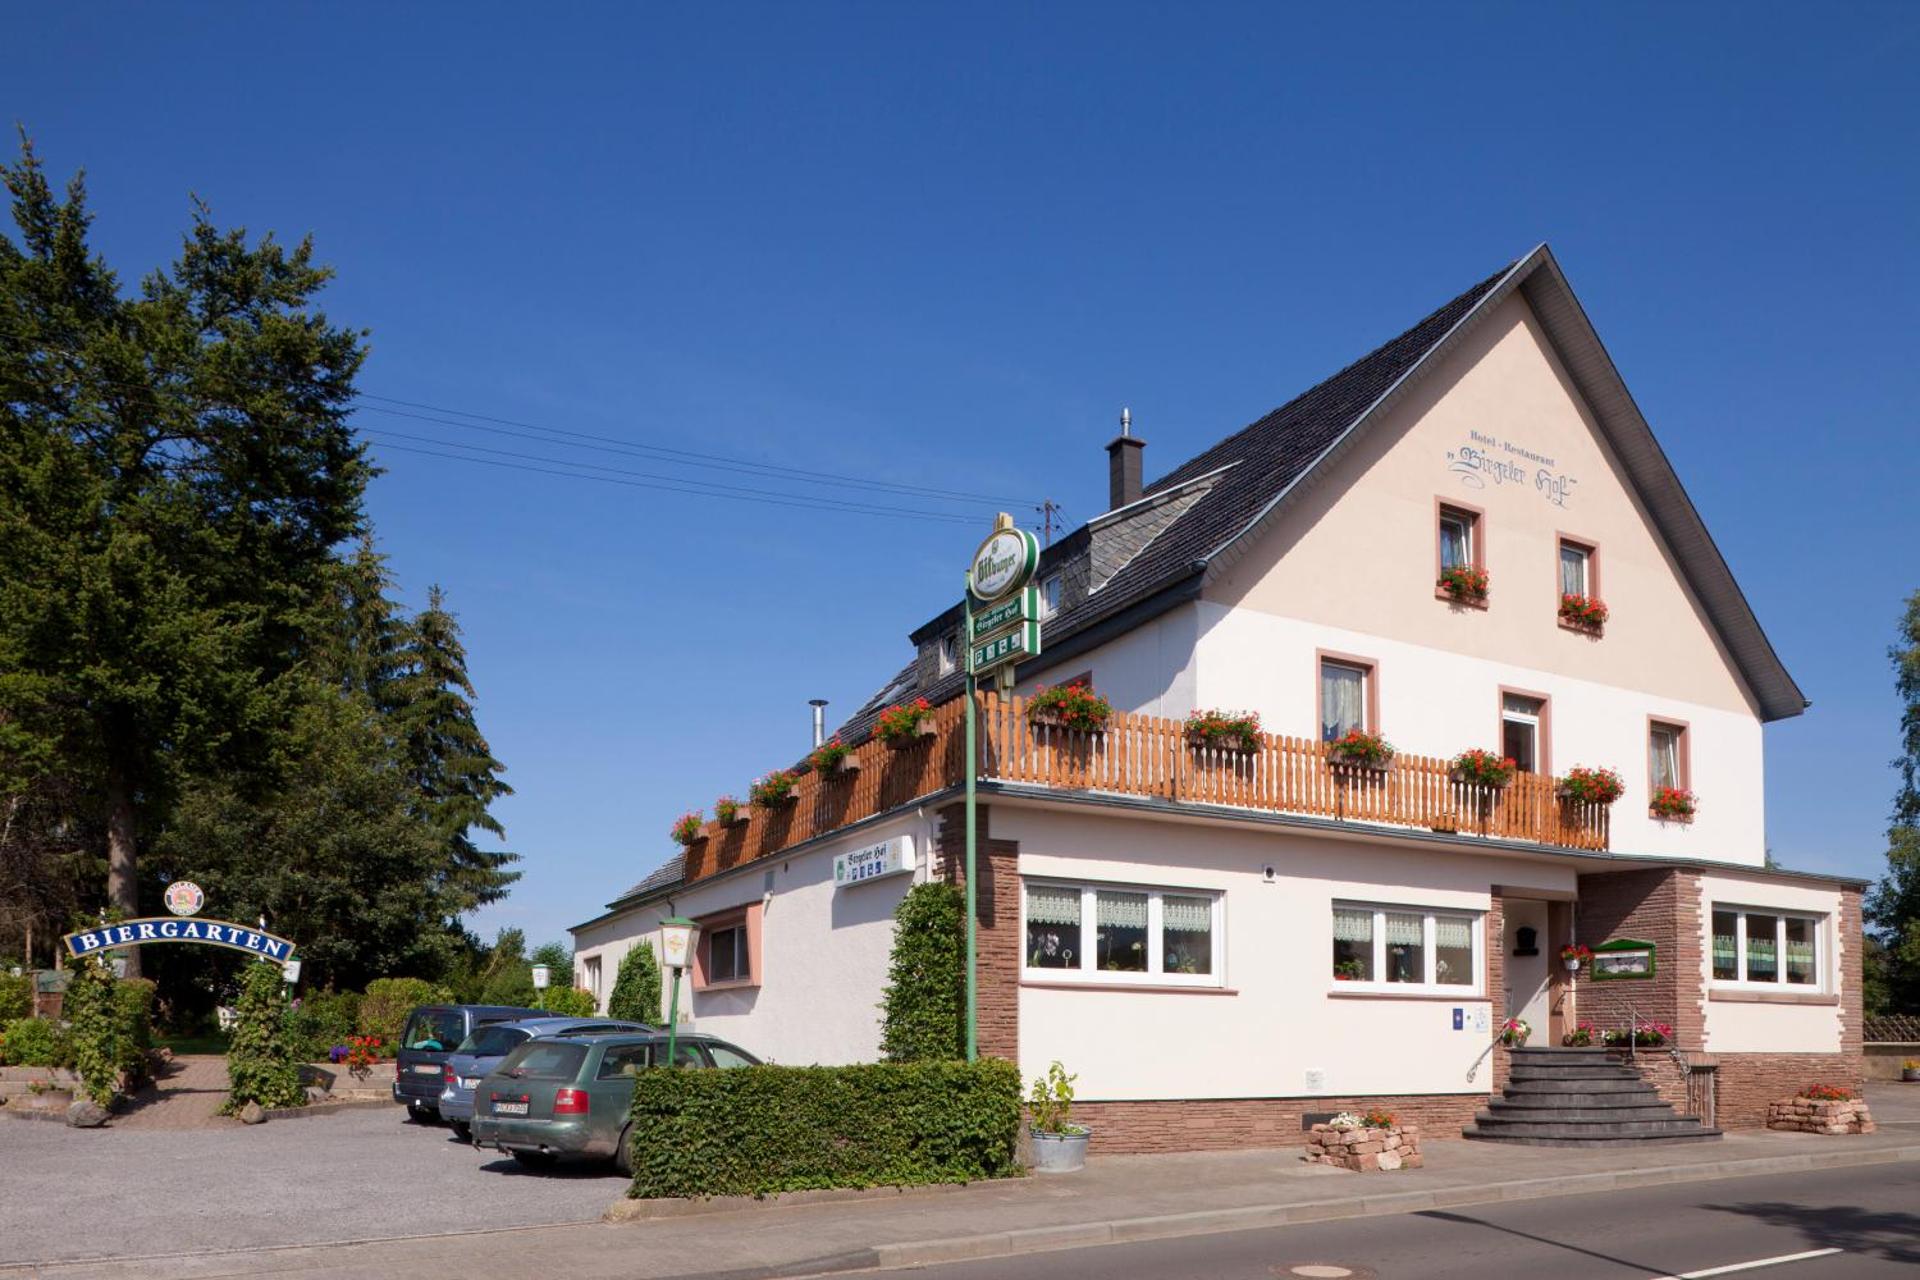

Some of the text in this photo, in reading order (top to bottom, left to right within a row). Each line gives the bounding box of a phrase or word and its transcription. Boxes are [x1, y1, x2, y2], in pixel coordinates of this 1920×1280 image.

[1470, 430, 1496, 447] Hotel
[1504, 441, 1555, 467] Restaurant
[79, 922, 283, 957] BIERGARTEN
